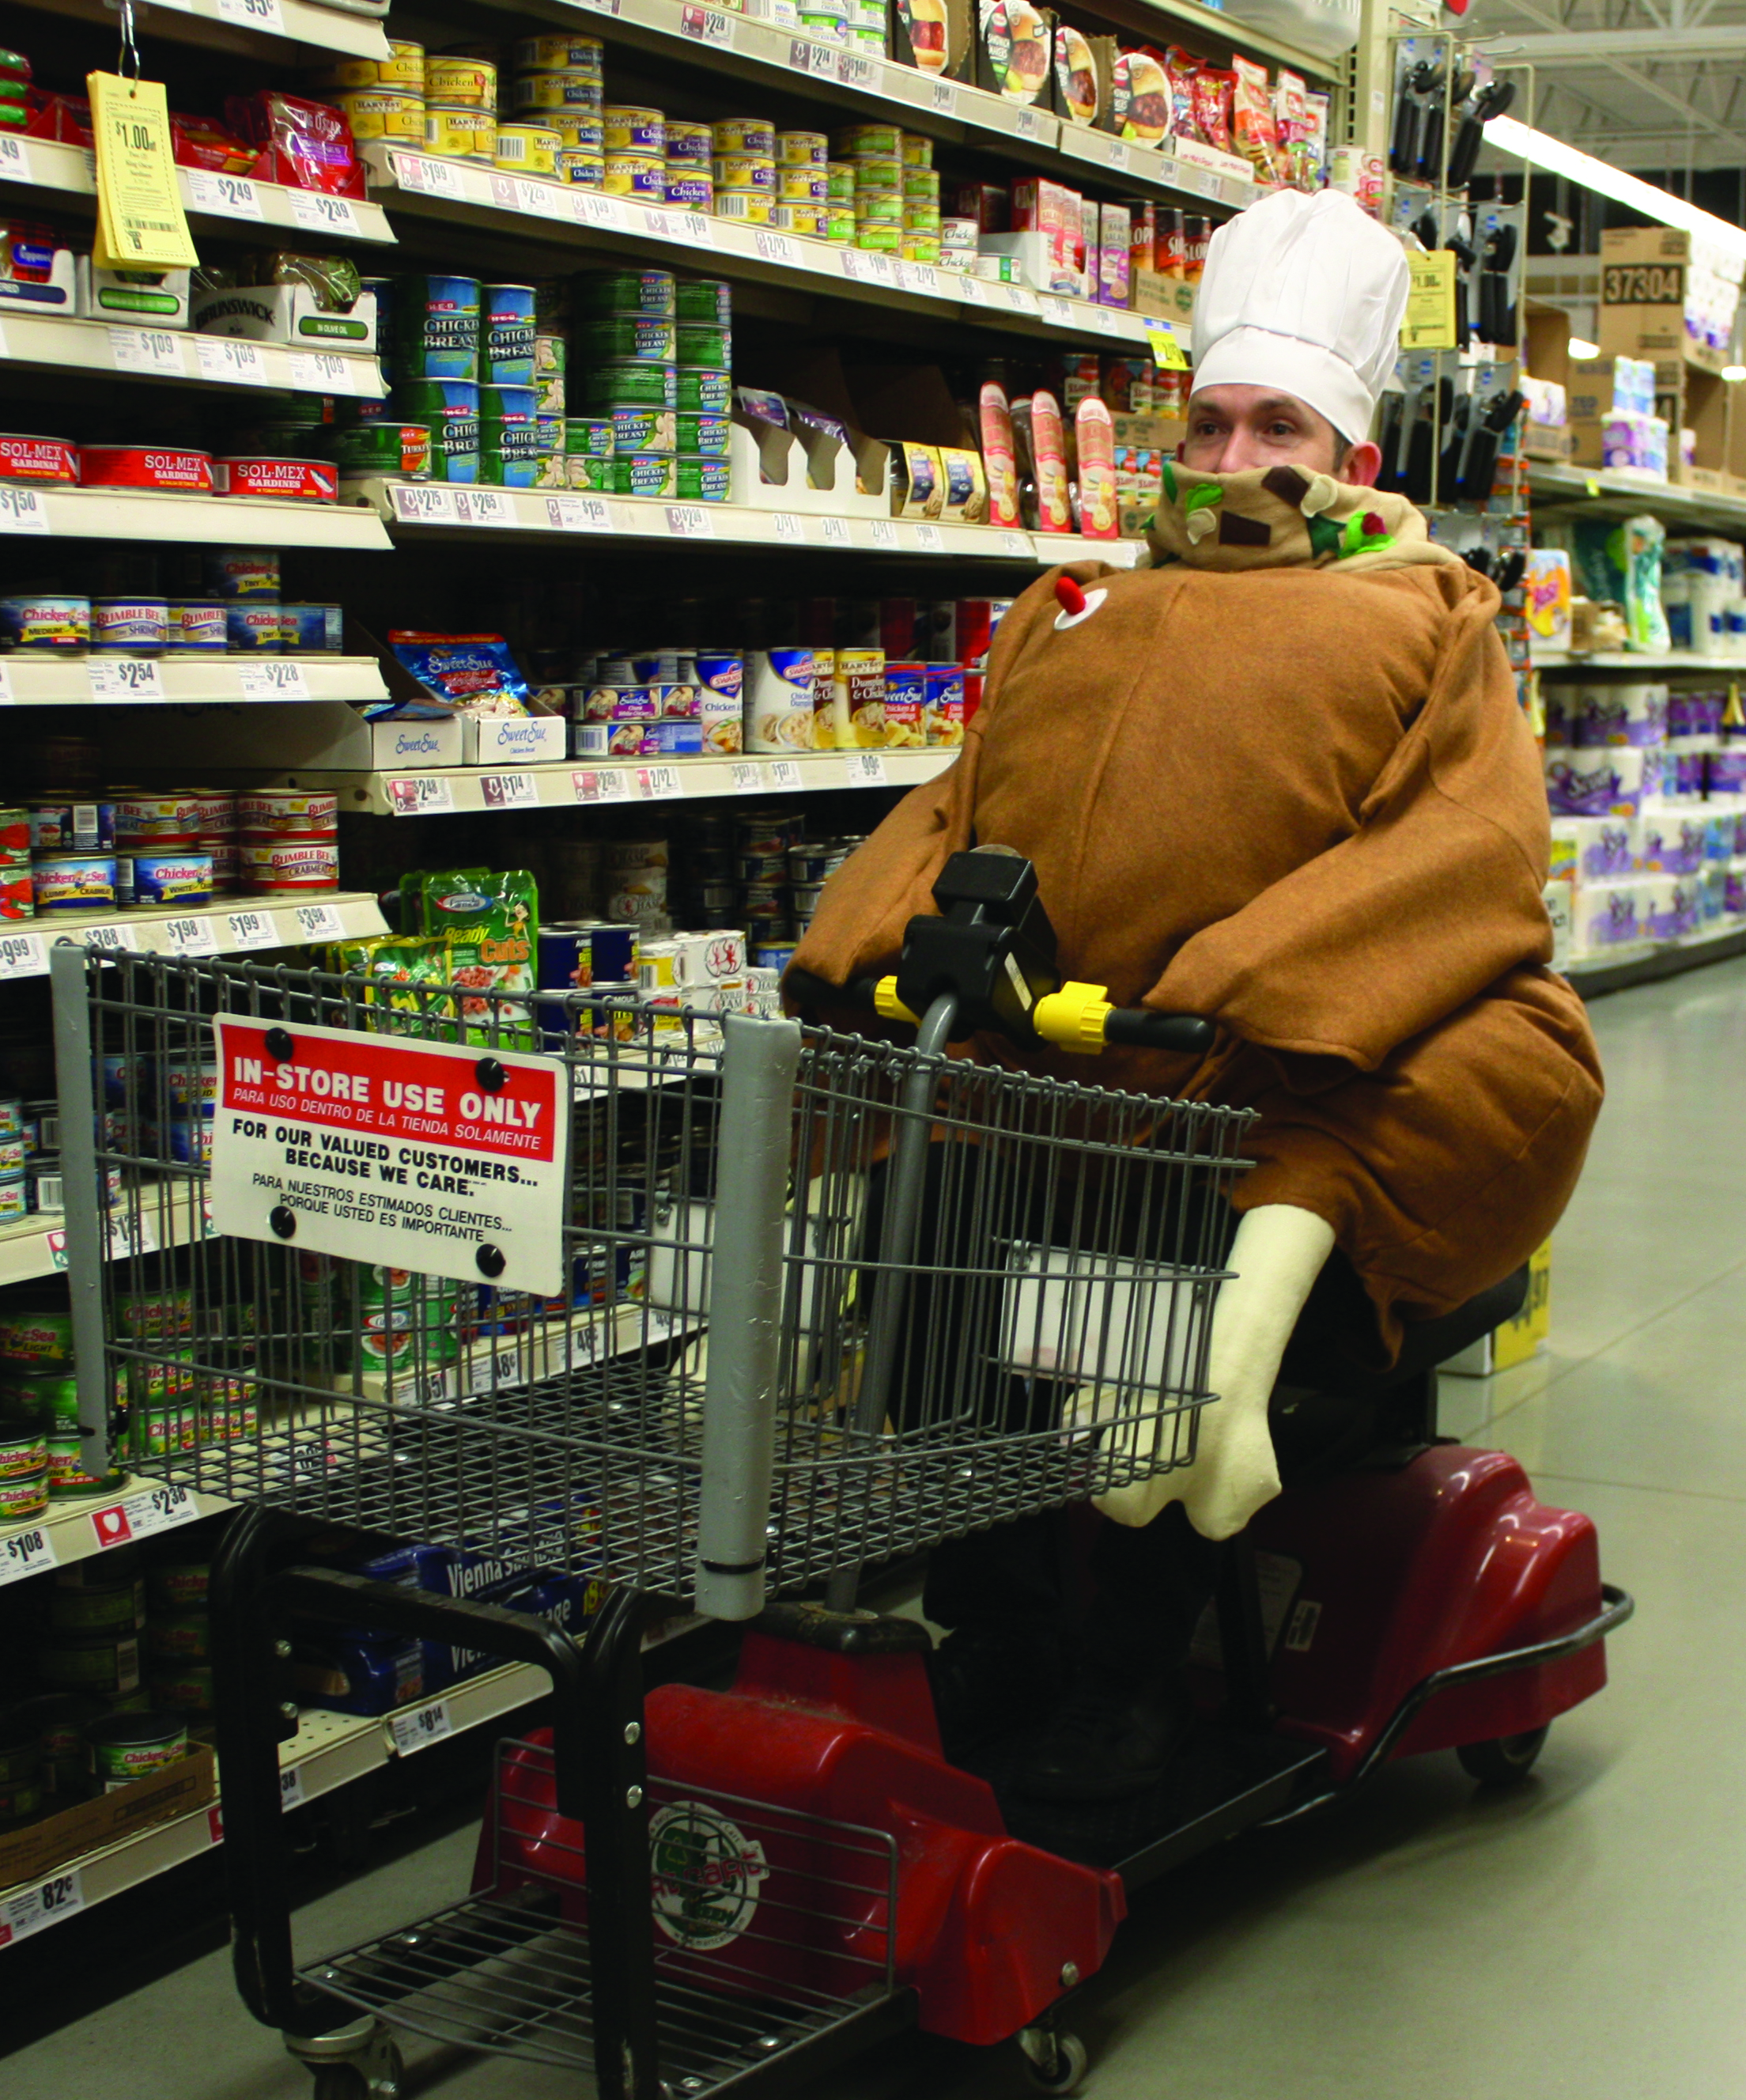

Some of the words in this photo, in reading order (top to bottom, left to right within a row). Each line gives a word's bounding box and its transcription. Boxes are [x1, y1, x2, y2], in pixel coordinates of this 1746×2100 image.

[421, 161, 448, 184] $199
[218, 179, 253, 205] $249
[671, 187, 706, 197] Chicken
[317, 199, 349, 221] $239
[1606, 267, 1680, 302] 37304
[195, 297, 275, 329] BRUNSWICK
[142, 332, 174, 359] $109
[488, 327, 536, 345] CHICKE
[225, 342, 255, 369] $109
[489, 344, 535, 361] BREAS
[315, 354, 345, 380] $109
[11, 458, 59, 471] SARDINAS
[154, 470, 198, 481] SARDINAS
[630, 468, 667, 479] CHICKEN
[248, 479, 301, 489] SARDINES
[630, 477, 663, 487] BREAST
[1, 490, 36, 518] $150
[418, 490, 441, 510] $275
[473, 493, 497, 514] $265
[583, 499, 604, 520] $125
[22, 609, 70, 622] Chicken
[96, 608, 144, 629] BUMBLE
[182, 611, 221, 629] BUMBLE
[119, 663, 154, 688] $254
[266, 664, 299, 688] $228
[705, 702, 737, 713] Chicken
[861, 756, 879, 776] 99¢
[502, 777, 523, 796] $174
[272, 849, 315, 868] BUMBLE
[154, 868, 198, 880] Chicken
[169, 884, 193, 894] WHITE
[168, 920, 198, 944] $198
[229, 914, 259, 939] $199
[299, 908, 326, 933] $398
[444, 925, 489, 944] Ready
[480, 938, 529, 963] Cuts
[235, 1057, 369, 1103] IN-STORE
[384, 1080, 444, 1115] USE
[459, 1092, 541, 1129] ONLY
[233, 1088, 264, 1105] PARA
[270, 1094, 296, 1110] USO
[300, 1099, 352, 1120] DENTRO
[357, 1107, 373, 1122] DE
[378, 1111, 395, 1127] LA
[402, 1116, 448, 1136] TIENDA
[455, 1124, 541, 1151] SOLAMENTE
[232, 1118, 266, 1140] FOR
[275, 1126, 312, 1148] OUR
[321, 1134, 390, 1161] VALUED
[399, 1148, 539, 1186] CUSTOMERS...
[285, 1150, 370, 1179] BECAUSE
[380, 1165, 407, 1185] WE
[252, 1173, 282, 1190] PARA
[288, 1179, 353, 1203] NUESTROS
[359, 1193, 433, 1217] ESTIMADOS
[439, 1207, 512, 1232] CLIENTES...
[279, 1194, 329, 1215] PORQUE
[334, 1202, 375, 1224] USTED
[380, 1213, 396, 1227] ES
[402, 1216, 485, 1243] IMPORTANTE
[23, 1344, 53, 1354] LIGHT
[152, 1487, 187, 1515] $238
[9, 1531, 43, 1561] $108
[447, 1559, 503, 1599] Vienna
[419, 1705, 443, 1732] $814
[42, 1875, 74, 1911] 82¢
